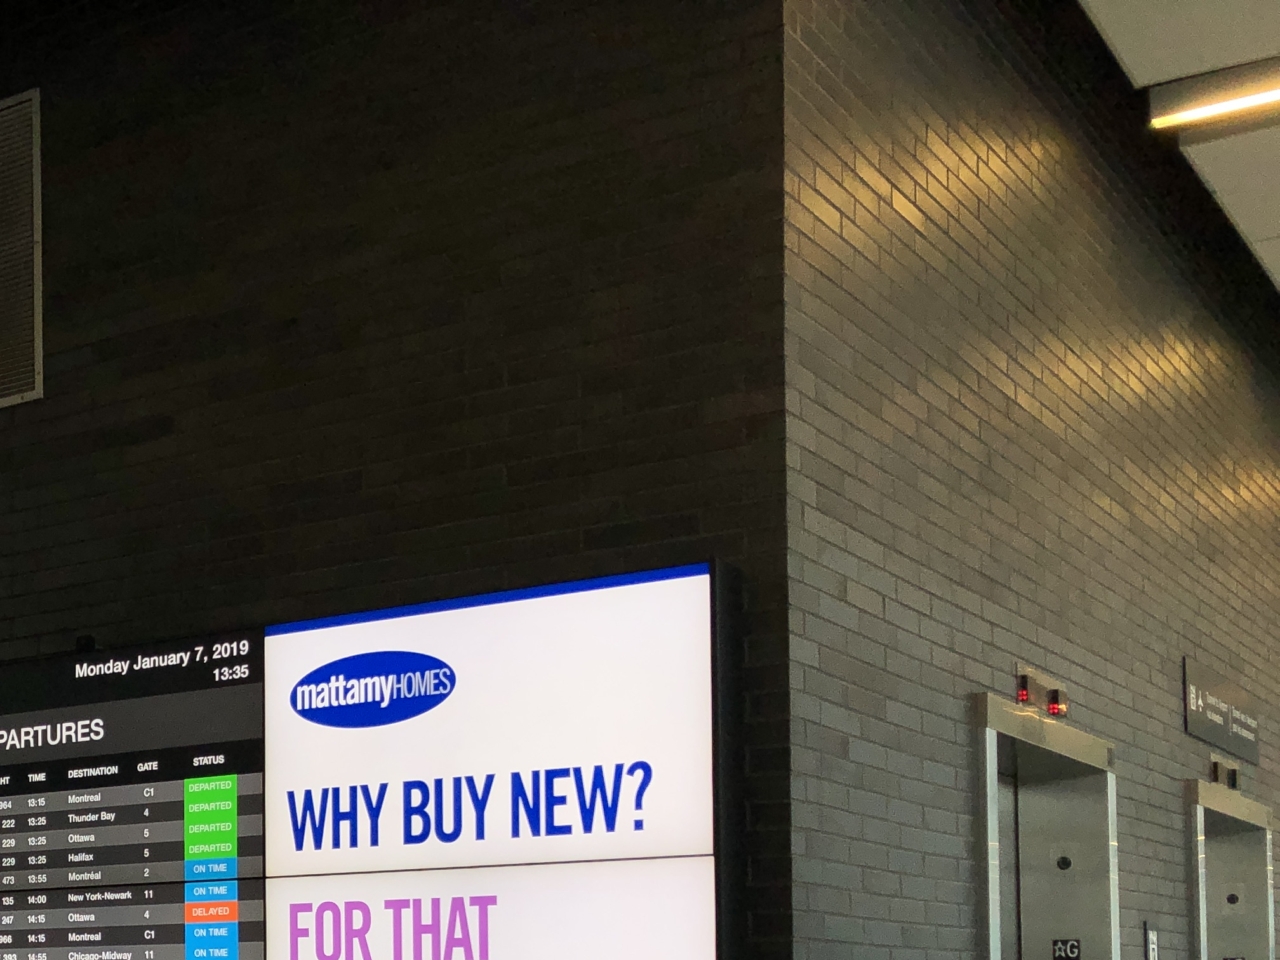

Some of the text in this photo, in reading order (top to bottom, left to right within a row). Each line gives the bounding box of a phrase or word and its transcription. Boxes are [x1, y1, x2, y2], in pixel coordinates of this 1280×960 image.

[76, 640, 248, 678] Monday January 7, 2019
[213, 665, 248, 682] 13:35
[296, 667, 452, 710] mattamyHOMES
[28, 772, 46, 782] TIME
[68, 765, 118, 779] DESTINATION
[137, 761, 158, 772] GATE
[193, 754, 224, 766] STATUS
[28, 797, 46, 808] 13:15
[68, 793, 101, 804] Montreal
[143, 787, 154, 798] C1
[189, 780, 232, 793] DEPARTED
[287, 761, 653, 852] WHY BUY NEW?
[2, 818, 15, 828] 222
[28, 816, 46, 827] 13:25
[68, 812, 98, 824] Thunder
[100, 811, 115, 822] Bay
[144, 808, 148, 817] 4
[189, 801, 232, 813] DEPARTED
[2, 895, 14, 906] 135
[28, 894, 47, 905] 14:00
[68, 892, 83, 903] New
[85, 890, 132, 902] York-Newark
[144, 890, 153, 899] 11
[193, 886, 205, 896] ON
[208, 885, 227, 895] TIME
[2, 915, 14, 925] 247
[28, 913, 46, 924] 14:15
[68, 912, 95, 922] Ottawa
[144, 910, 149, 919] 4
[192, 906, 229, 917] DELAYED
[144, 951, 154, 960] 11
[194, 948, 206, 958] ON
[209, 948, 228, 958] TIME
